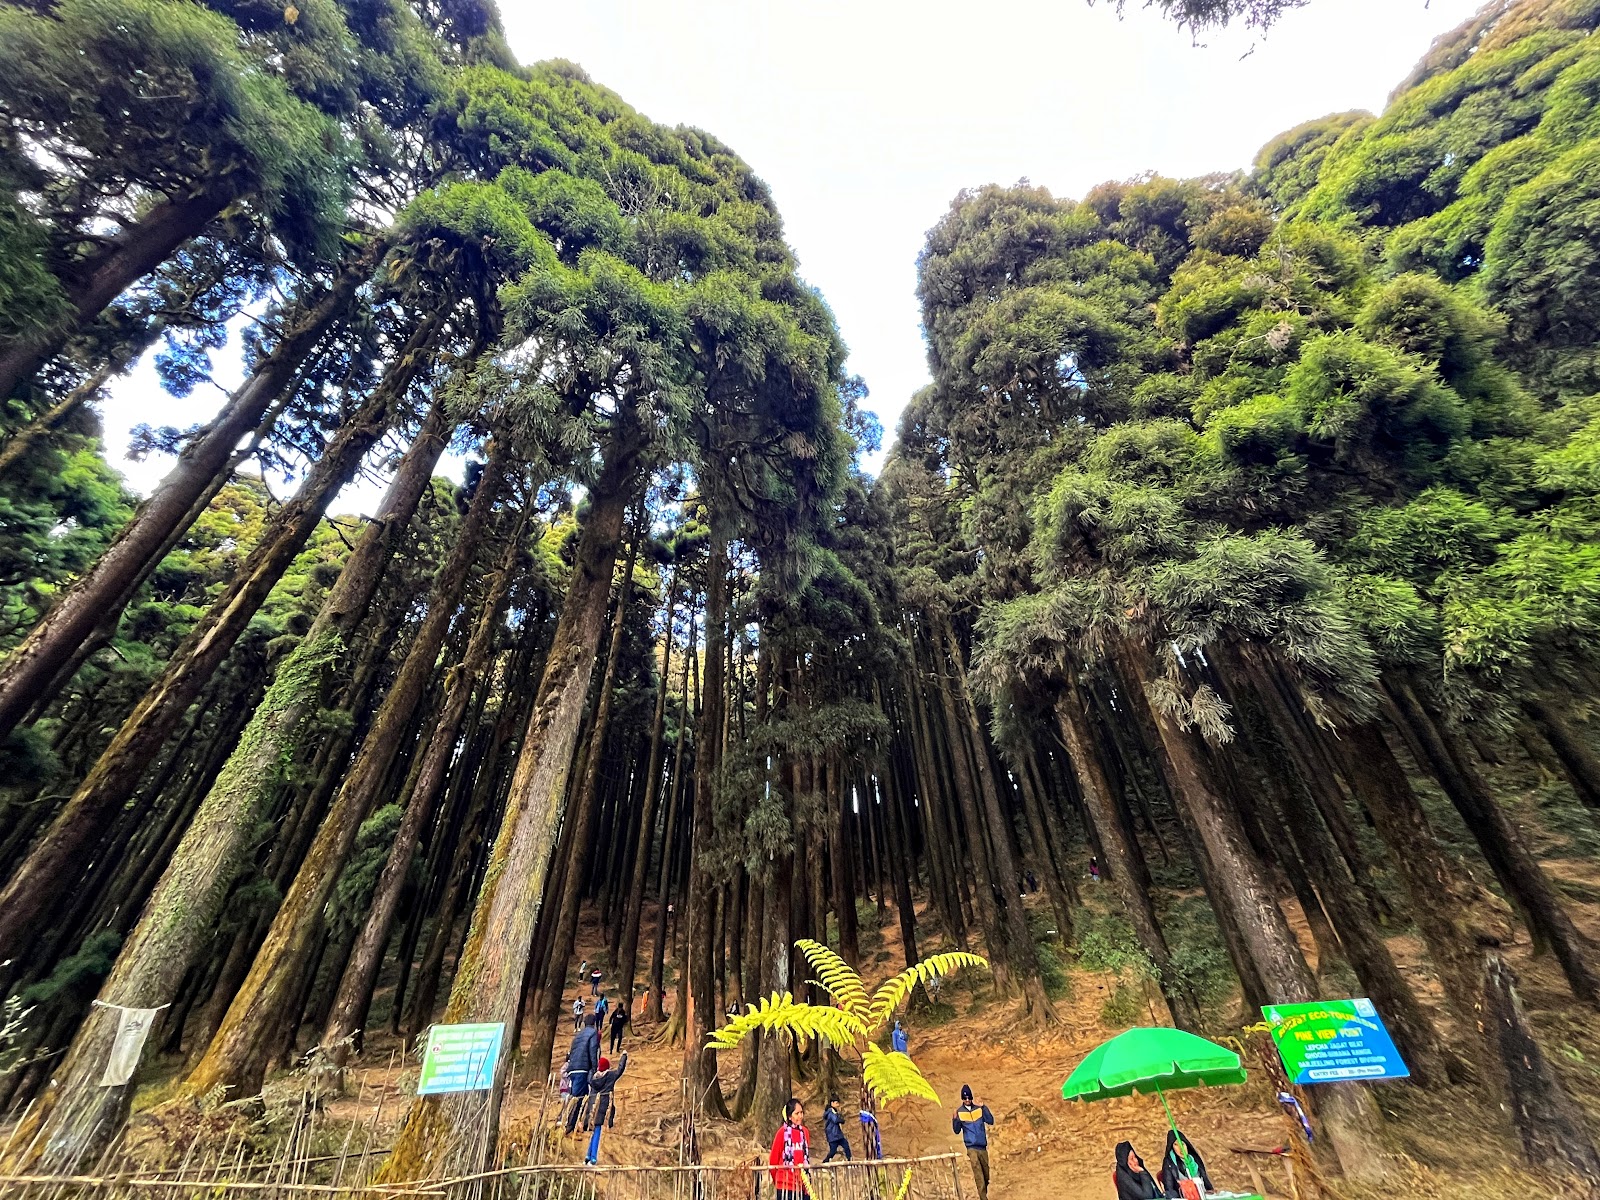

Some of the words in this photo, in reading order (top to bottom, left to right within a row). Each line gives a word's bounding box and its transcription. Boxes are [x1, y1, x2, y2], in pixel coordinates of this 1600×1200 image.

[1294, 1031, 1315, 1041] PINE
[1315, 1029, 1337, 1040] VIEW
[1339, 1027, 1363, 1038] POINT
[1304, 1043, 1329, 1051] LEPCHA
[1297, 1060, 1335, 1068] DARJEELING
[1335, 1057, 1359, 1066] FOREST
